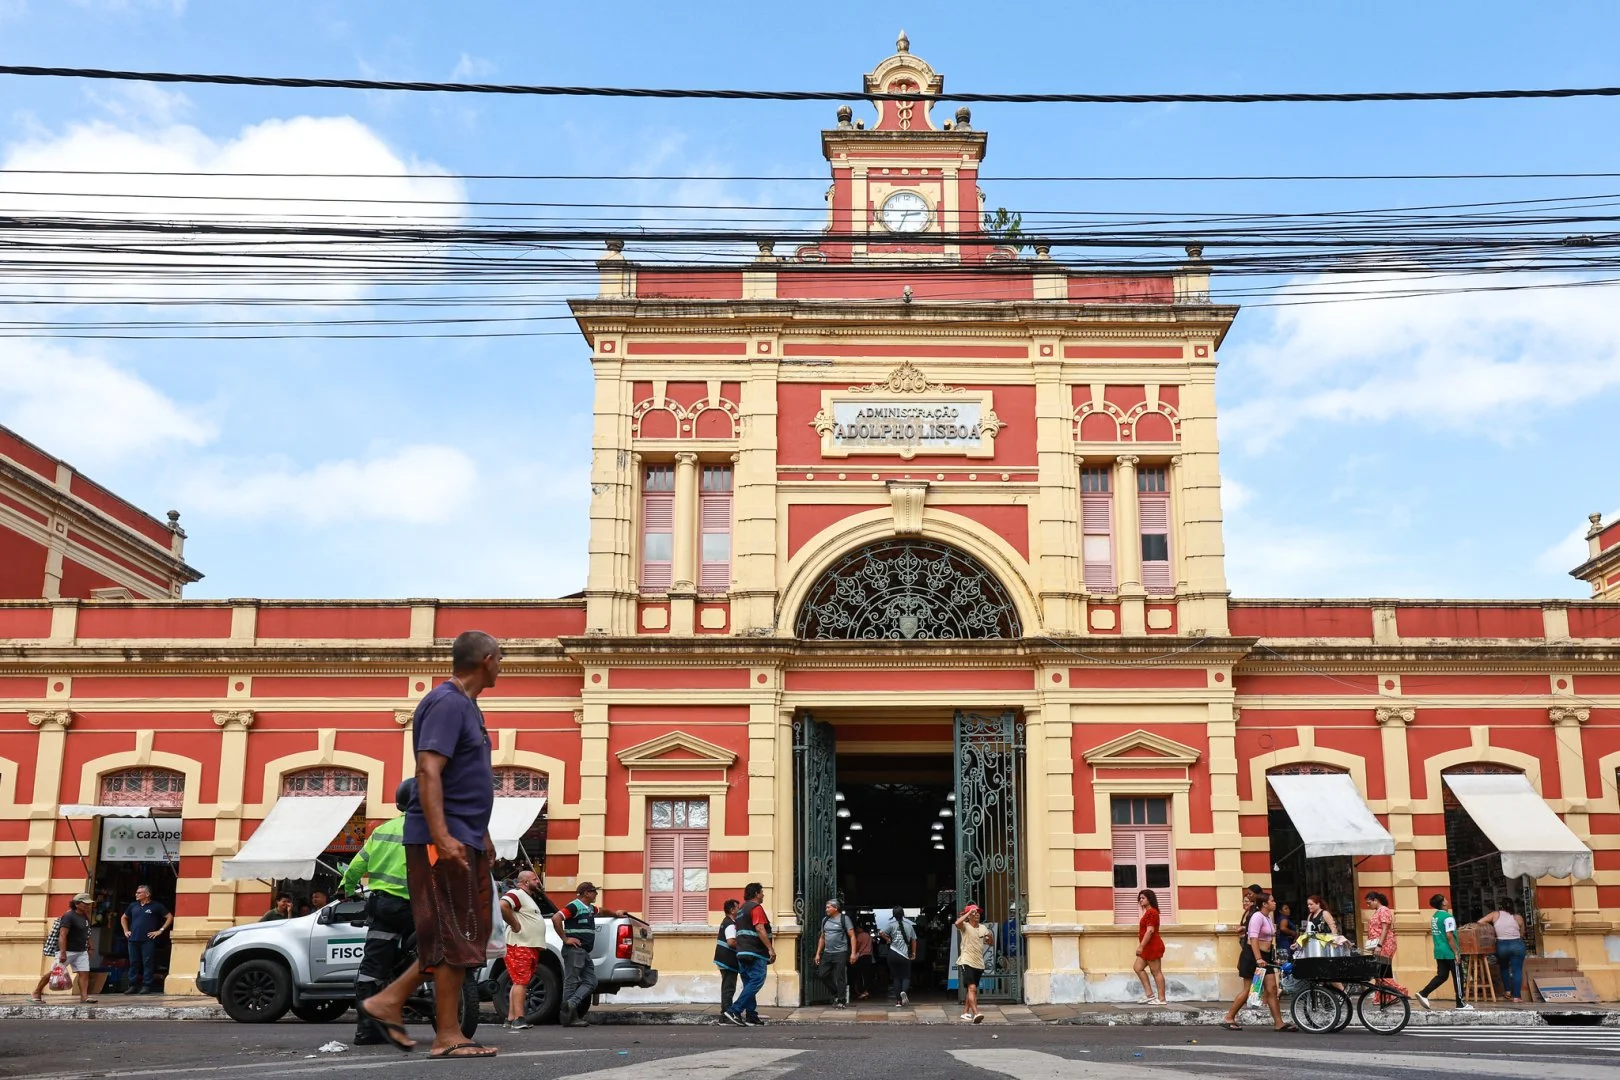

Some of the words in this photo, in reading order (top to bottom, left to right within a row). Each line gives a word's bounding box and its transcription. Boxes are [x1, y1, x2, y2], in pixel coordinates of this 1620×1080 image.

[856, 406, 959, 420] ADMINISTRAÇÃO
[835, 423, 915, 440] ADOLPHO
[918, 424, 980, 440] LISBOA
[136, 830, 183, 842] cazape
